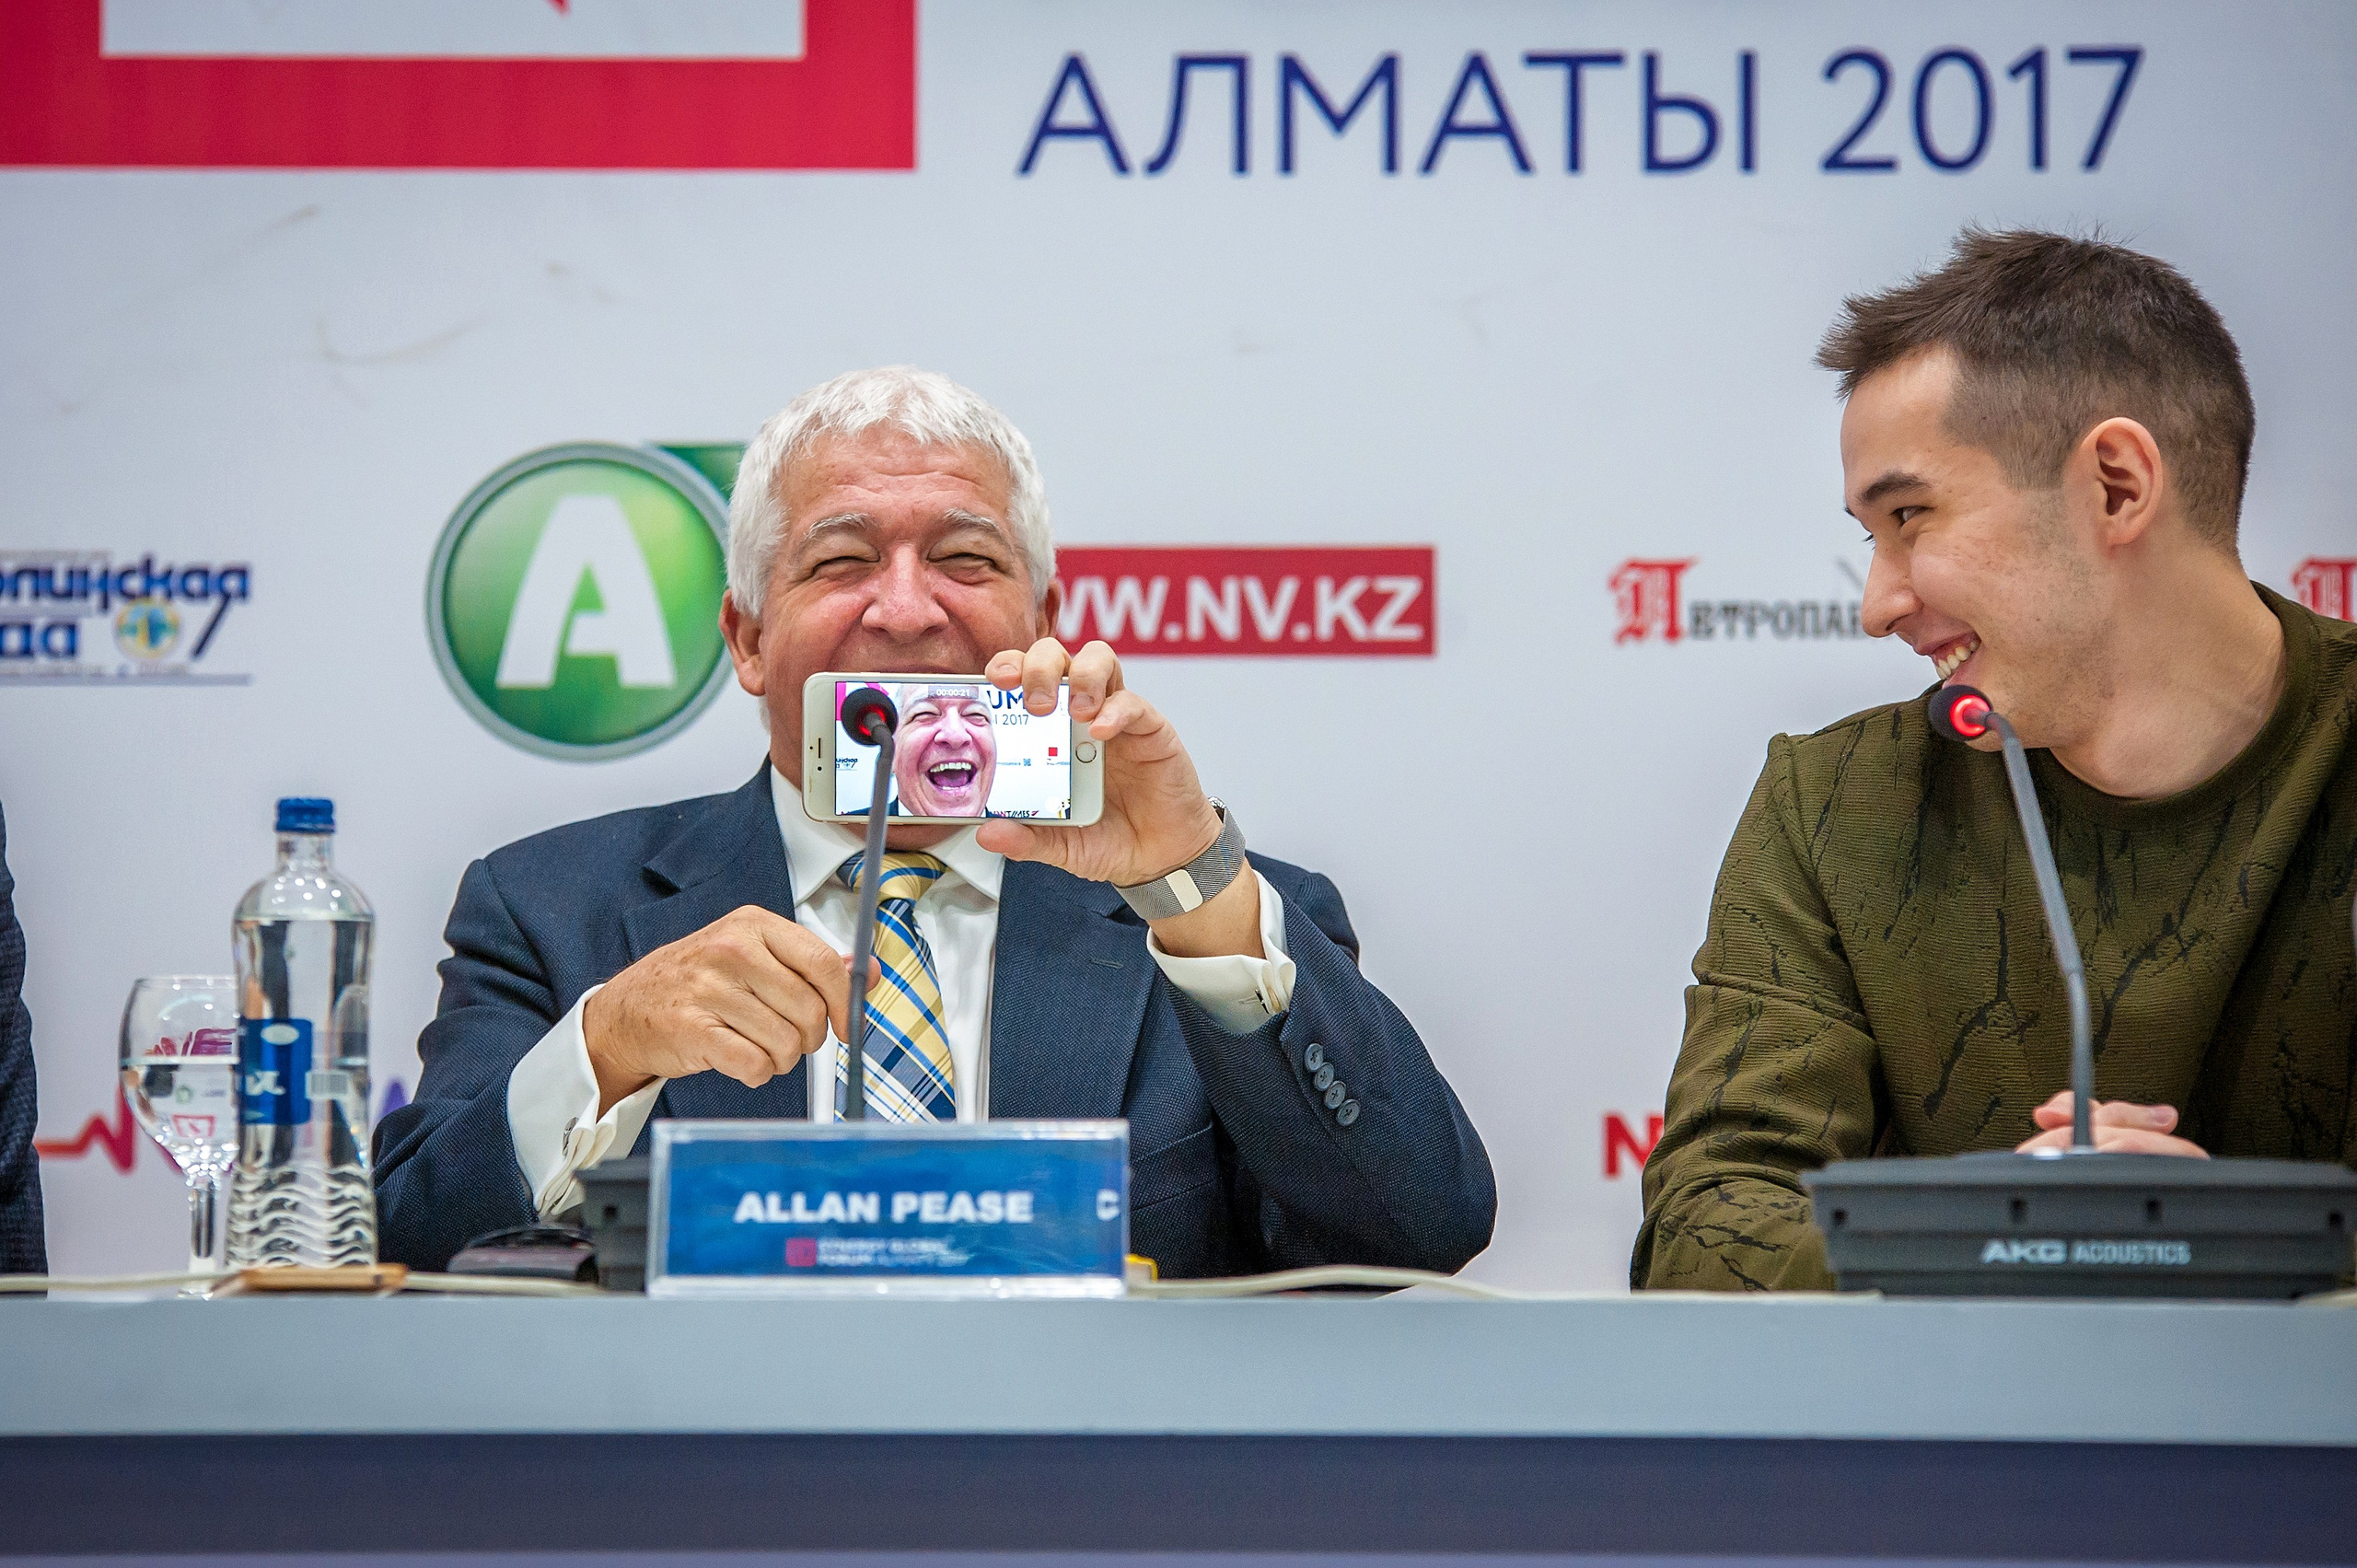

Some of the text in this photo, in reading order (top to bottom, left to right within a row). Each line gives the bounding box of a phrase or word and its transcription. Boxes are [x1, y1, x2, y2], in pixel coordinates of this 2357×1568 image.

[1016, 44, 2143, 177] АЛМАТЫ 2017
[936, 689, 970, 697] 00:00:21
[1002, 714, 1029, 726] 2017
[736, 1191, 1034, 1224] ALLAN PEASE
[1980, 1239, 2191, 1266] AKG ACOUSTICS
